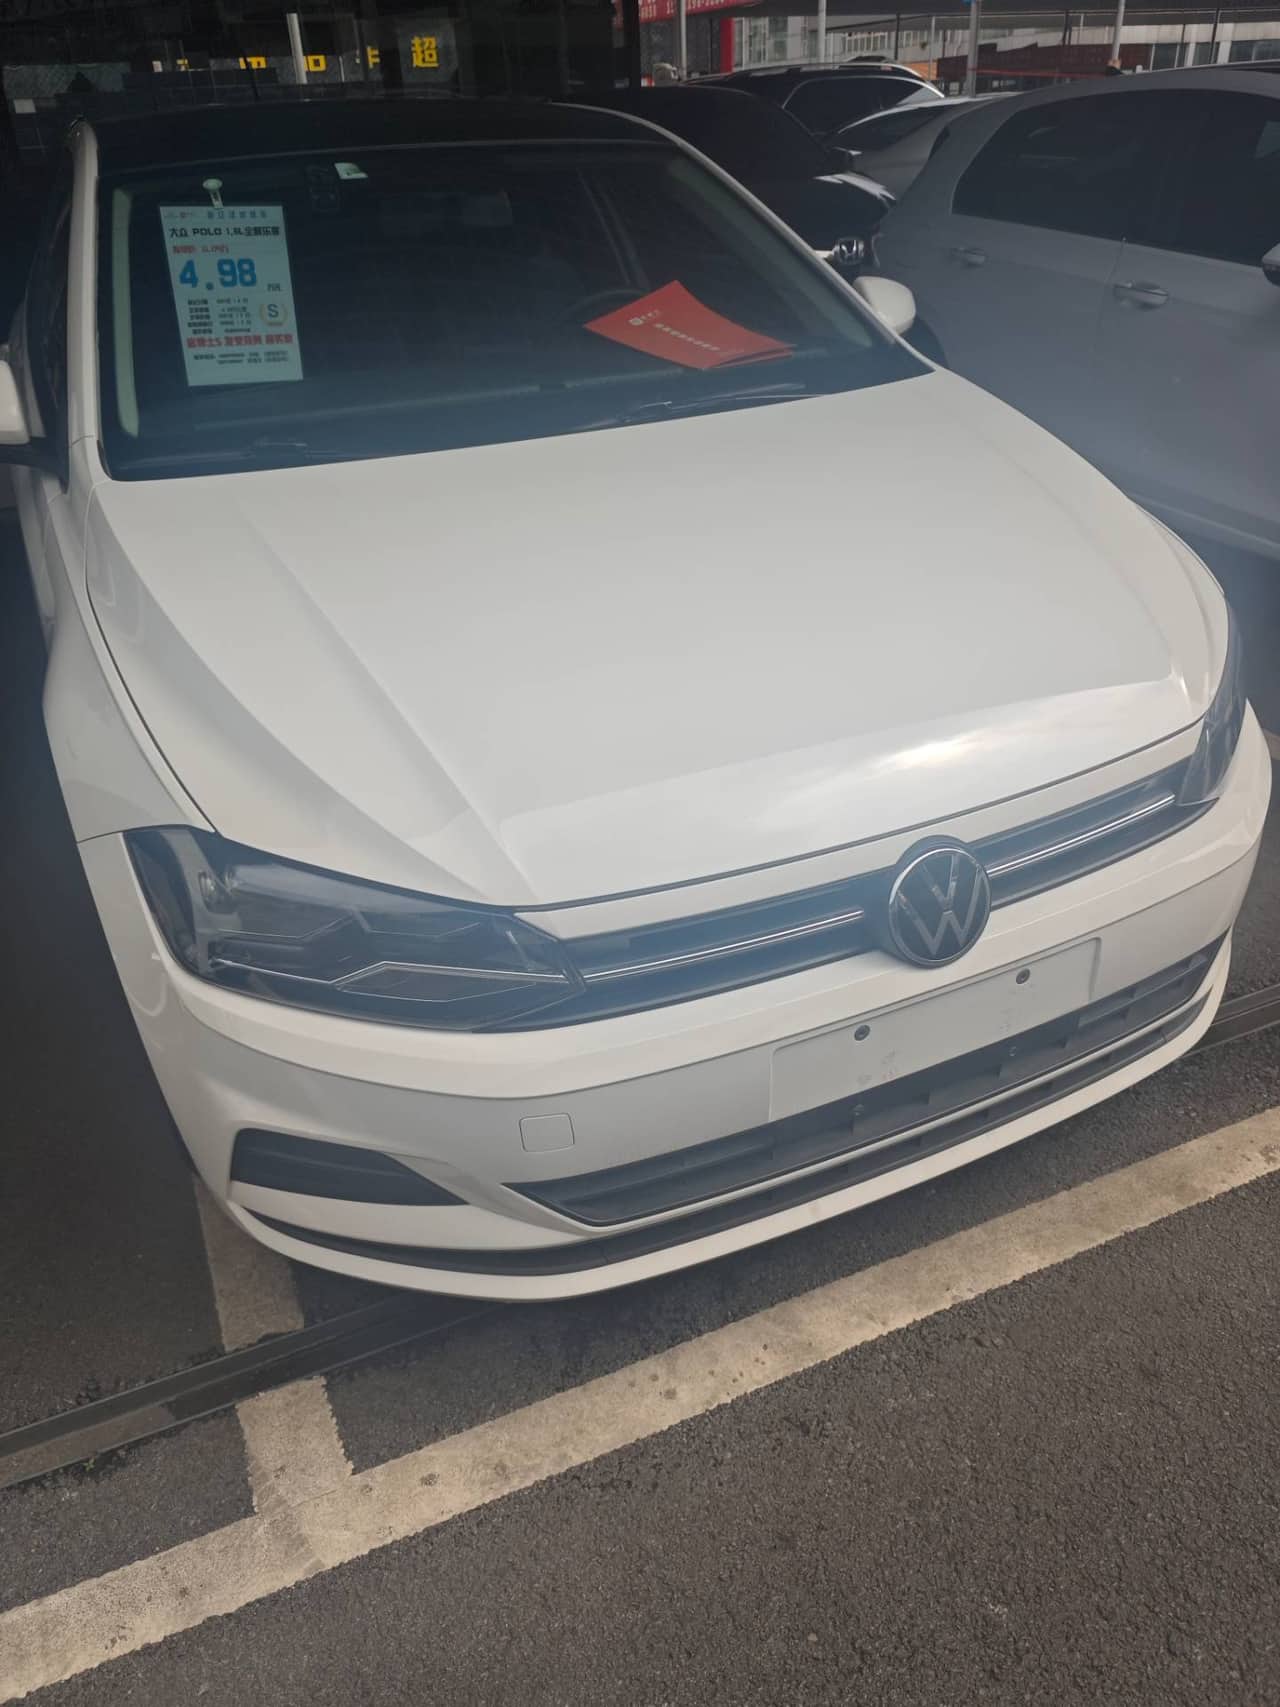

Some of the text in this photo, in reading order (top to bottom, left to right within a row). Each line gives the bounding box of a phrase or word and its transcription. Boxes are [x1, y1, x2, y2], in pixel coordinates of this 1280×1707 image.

[411, 36, 440, 68] 超
[192, 227, 222, 236] POLO
[179, 258, 257, 290] 4.98
[267, 303, 279, 318] S
